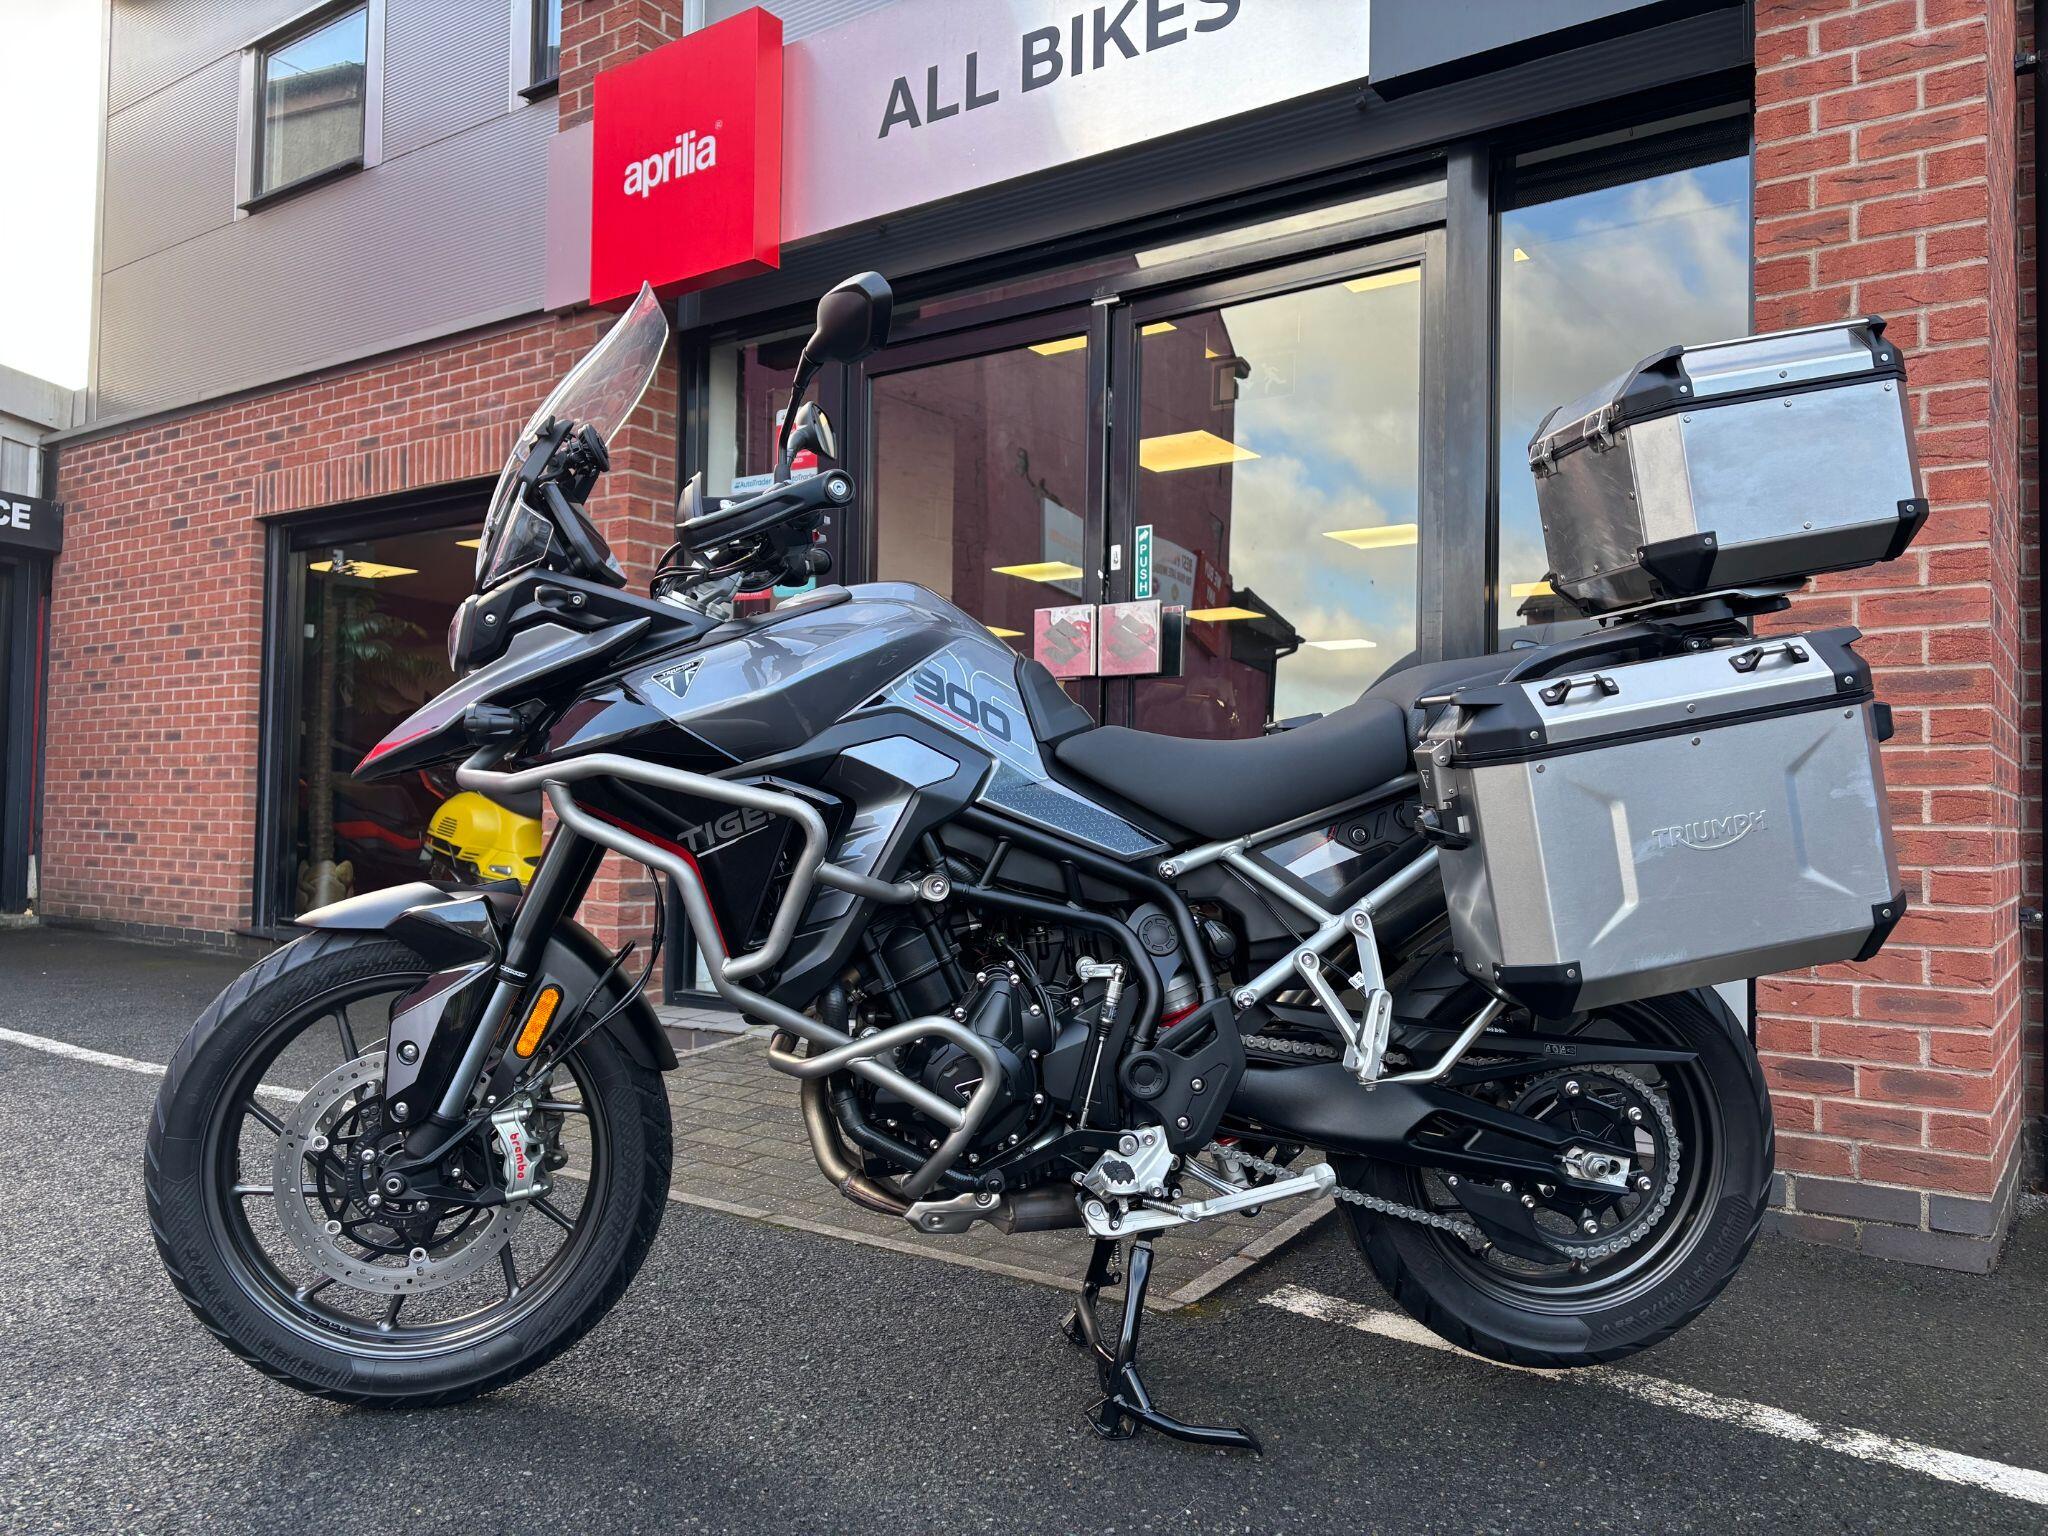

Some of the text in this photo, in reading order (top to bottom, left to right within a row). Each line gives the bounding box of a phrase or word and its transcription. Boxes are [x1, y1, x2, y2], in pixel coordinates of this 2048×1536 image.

[878, 51, 999, 139] ALL
[623, 129, 717, 199] aprilia
[1139, 543, 1148, 593] PUSH
[912, 662, 1012, 743] 900
[1651, 808, 1768, 850] TRIUMPH
[509, 1132, 528, 1179] brembo
